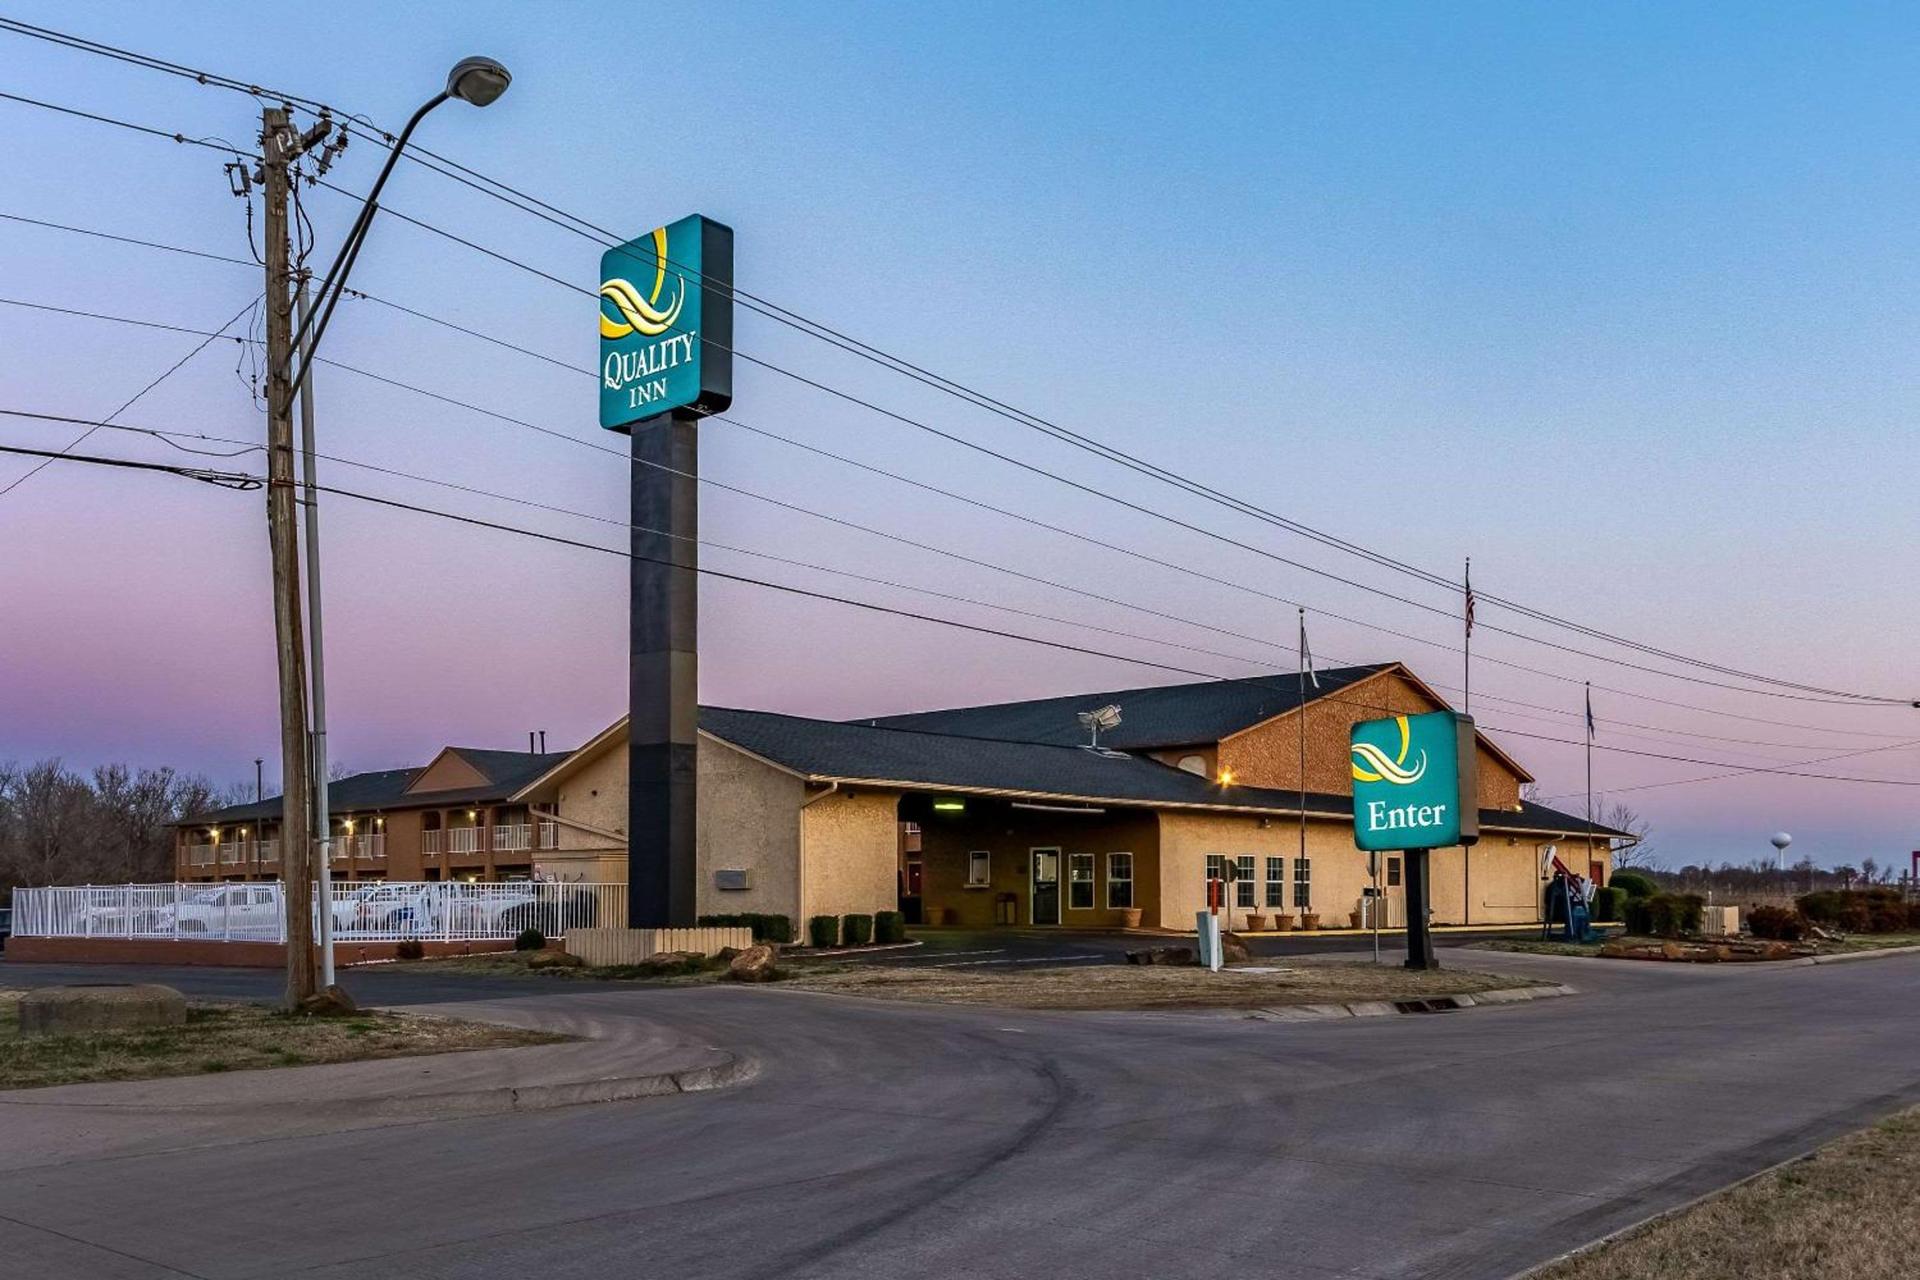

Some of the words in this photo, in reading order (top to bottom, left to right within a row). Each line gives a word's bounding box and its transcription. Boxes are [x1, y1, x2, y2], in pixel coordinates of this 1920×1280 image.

[605, 331, 696, 390] QUALITY
[629, 378, 667, 409] INN
[1368, 801, 1446, 831] Enter
